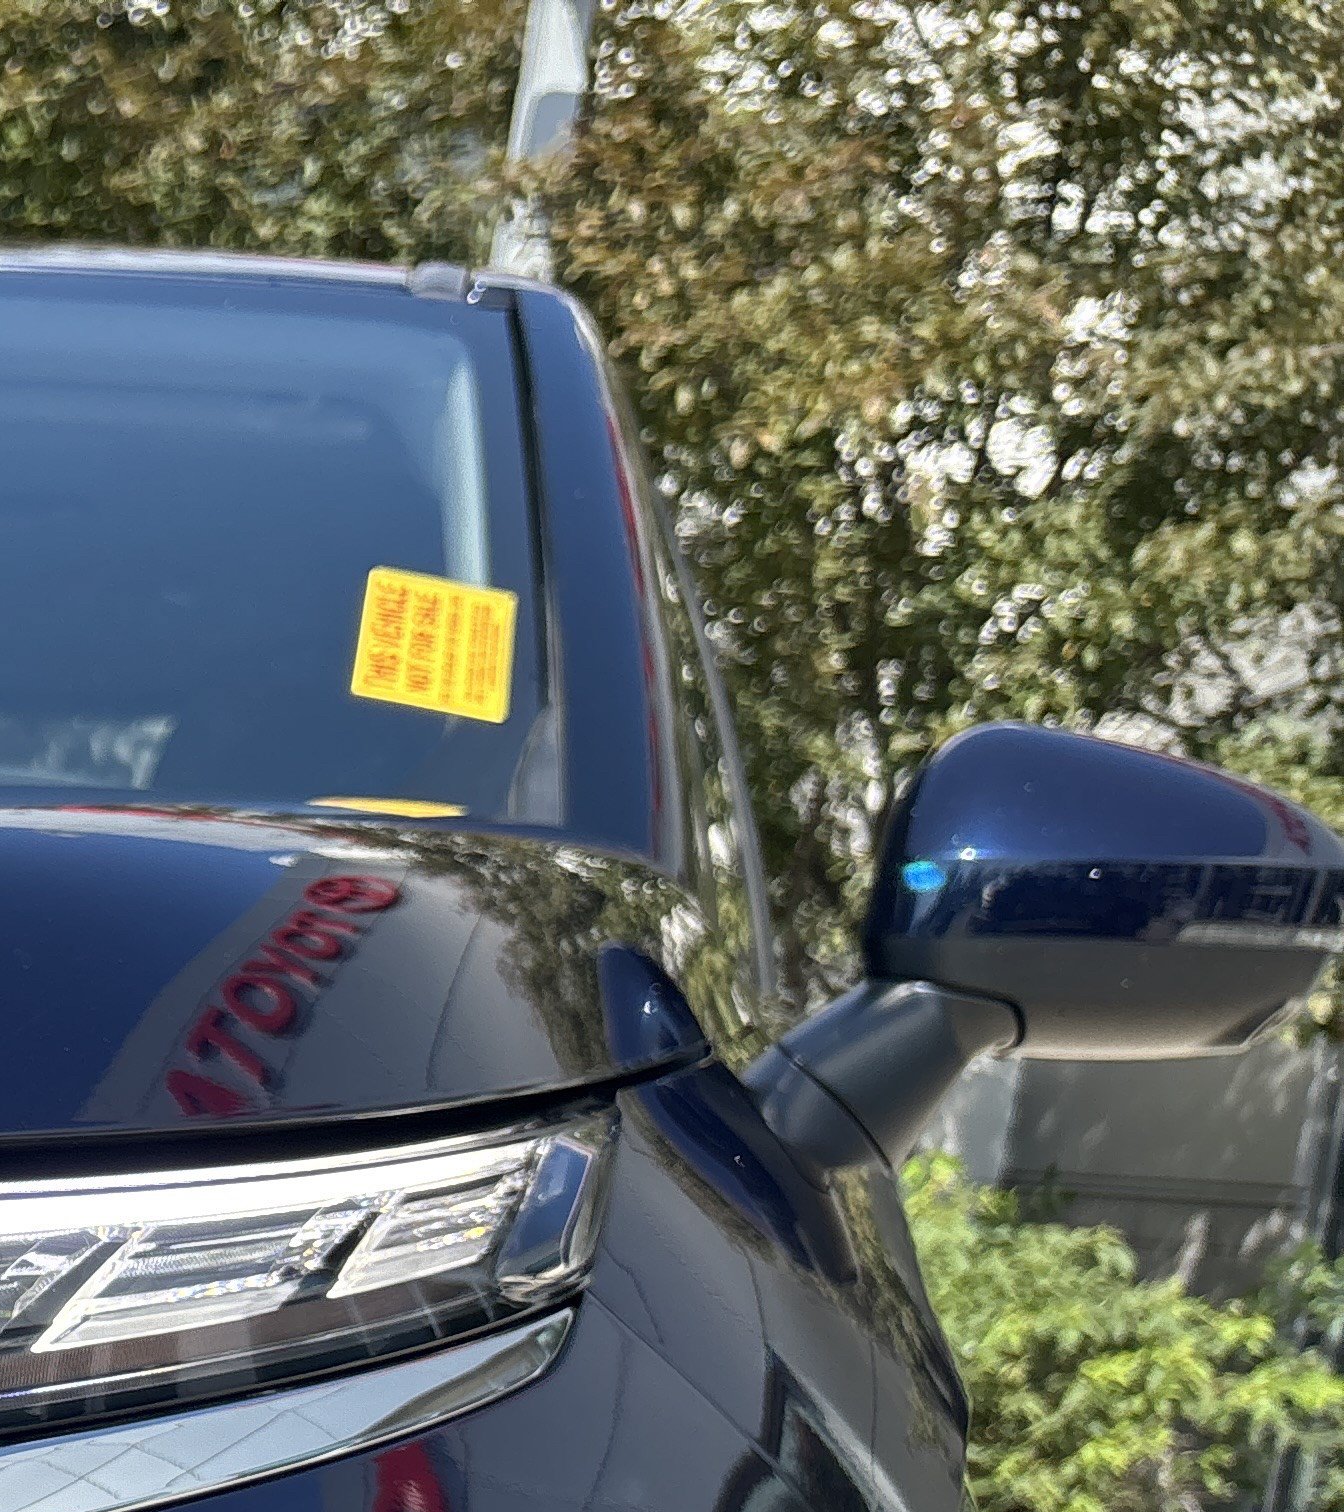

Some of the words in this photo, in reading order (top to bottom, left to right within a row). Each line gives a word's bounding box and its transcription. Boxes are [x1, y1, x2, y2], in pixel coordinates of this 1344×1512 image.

[372, 581, 408, 648] VEHICLE
[414, 591, 439, 628] SALE
[407, 663, 434, 693] NOT
